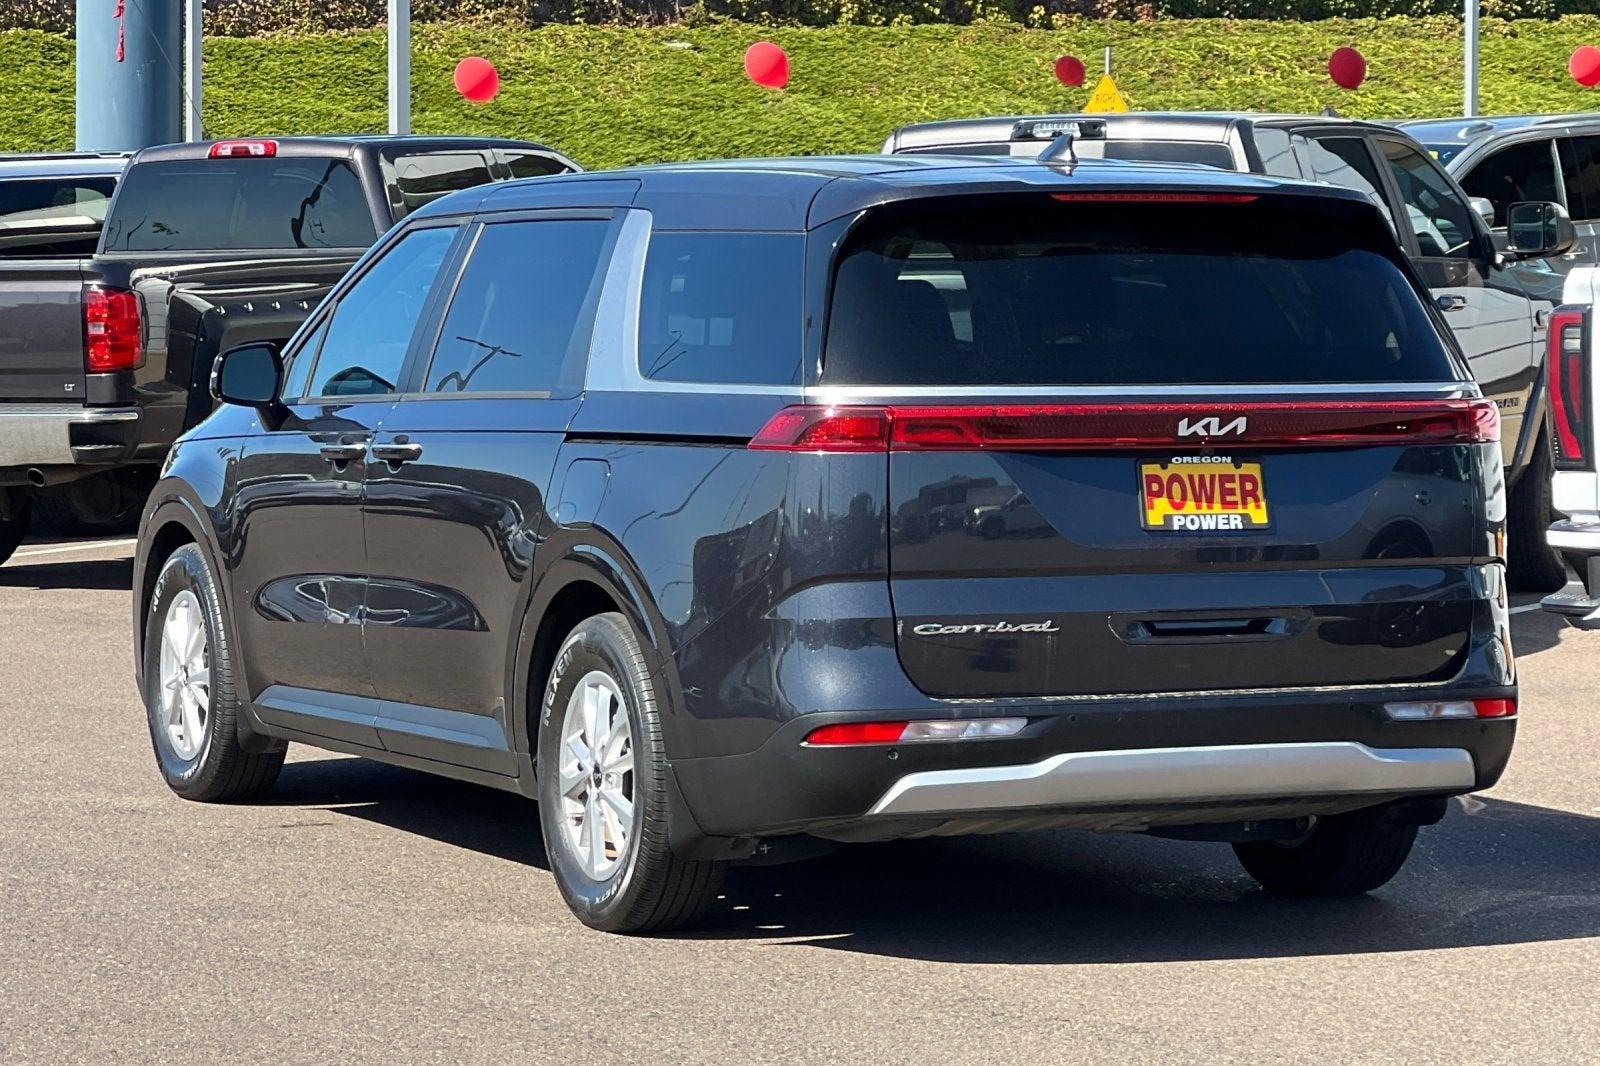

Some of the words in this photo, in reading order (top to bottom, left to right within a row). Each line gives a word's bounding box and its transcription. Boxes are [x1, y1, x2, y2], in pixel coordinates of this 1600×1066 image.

[1178, 416, 1247, 436] KIA
[1171, 456, 1232, 464] OREGON
[1144, 472, 1262, 511] POWER
[1172, 514, 1243, 530] POWER
[913, 619, 1060, 635] Carnival
[543, 648, 574, 727] NEXEN
